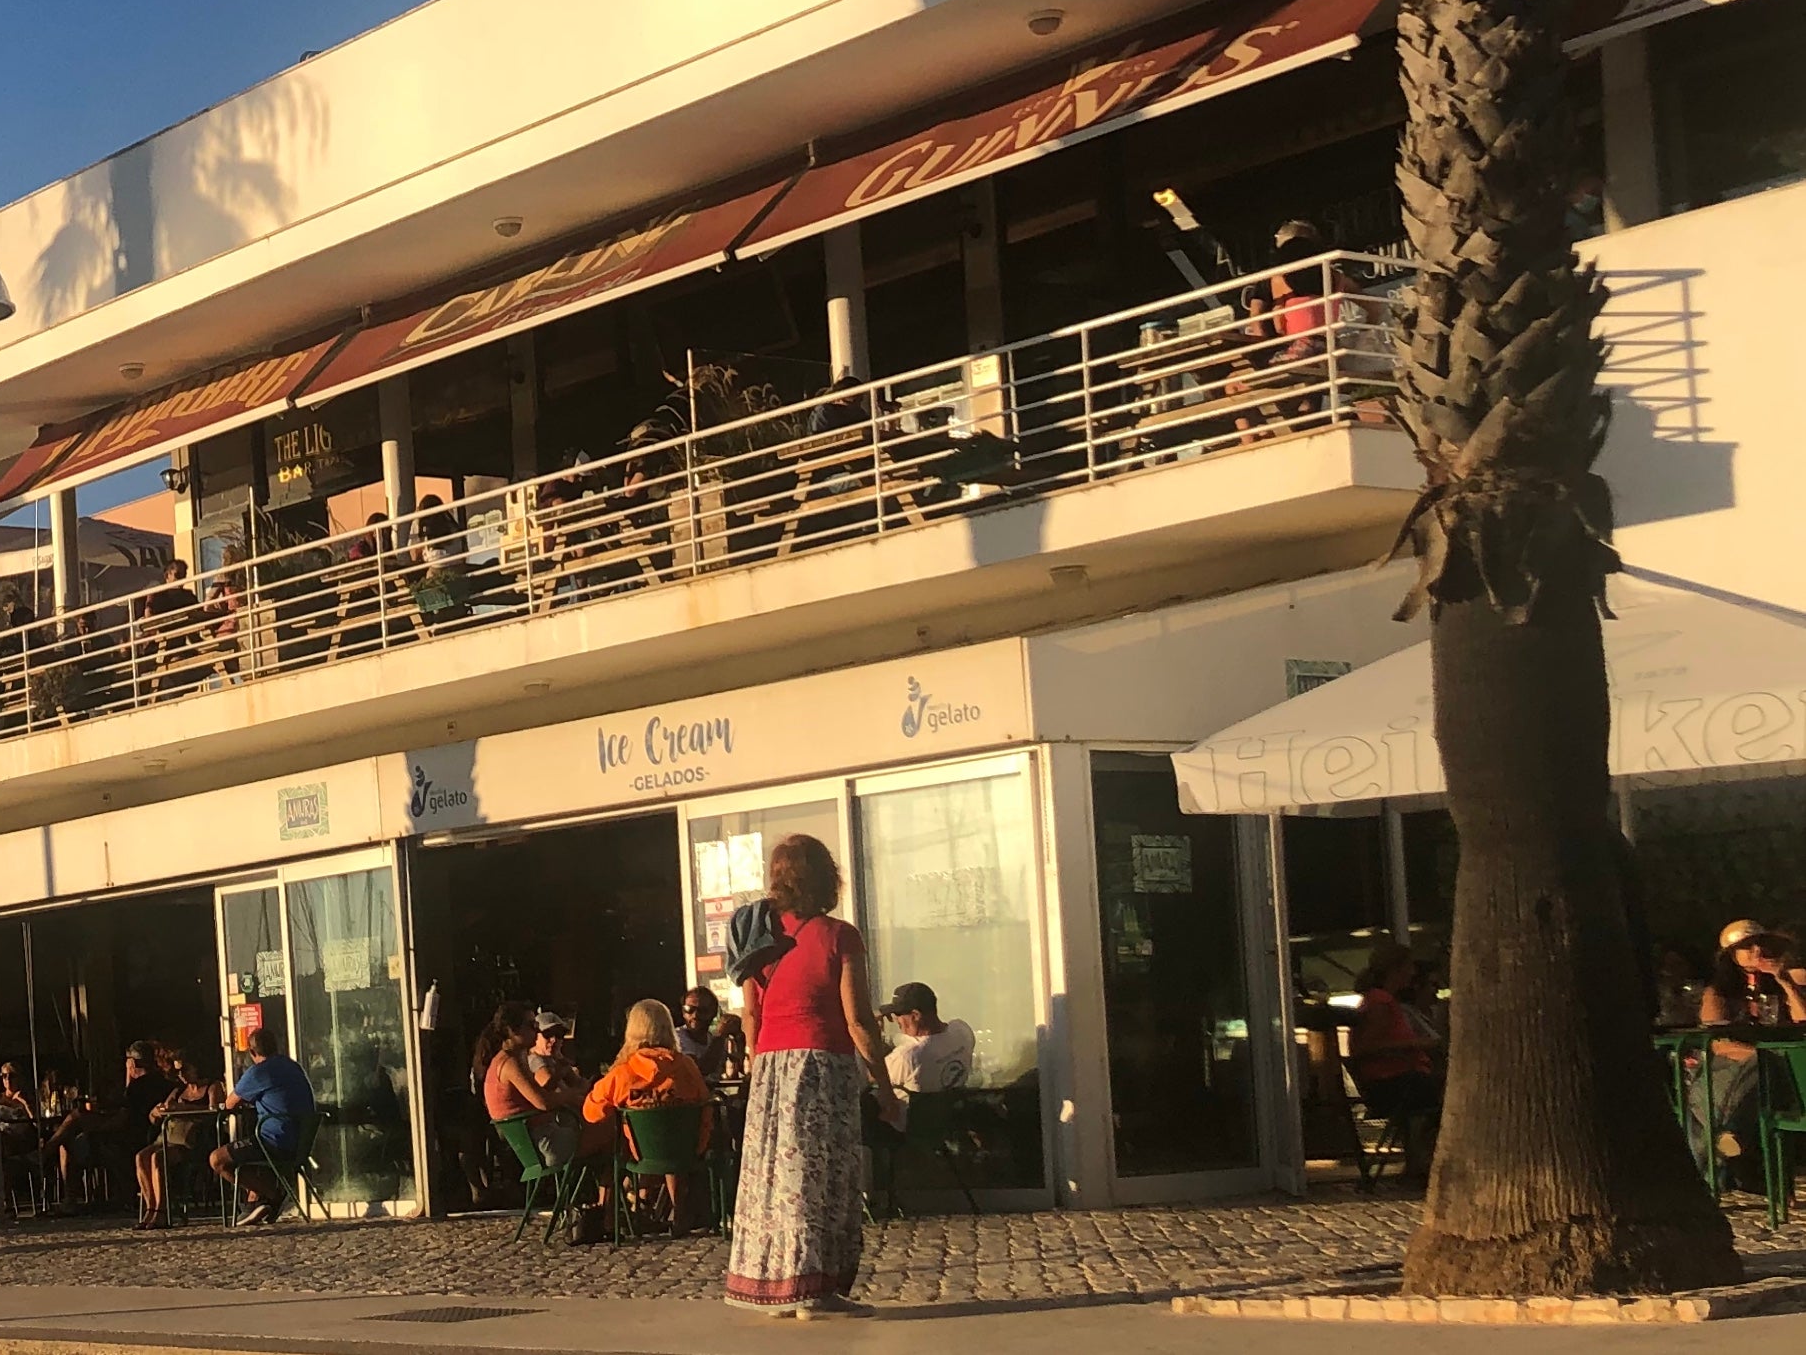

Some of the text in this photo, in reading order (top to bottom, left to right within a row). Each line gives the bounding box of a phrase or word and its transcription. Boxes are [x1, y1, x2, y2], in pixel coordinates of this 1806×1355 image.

[274, 429, 301, 462] THE
[927, 703, 981, 734] gelato
[598, 716, 736, 774] Ice Cream
[1205, 689, 1806, 812] Heike
[429, 789, 468, 814] gelato
